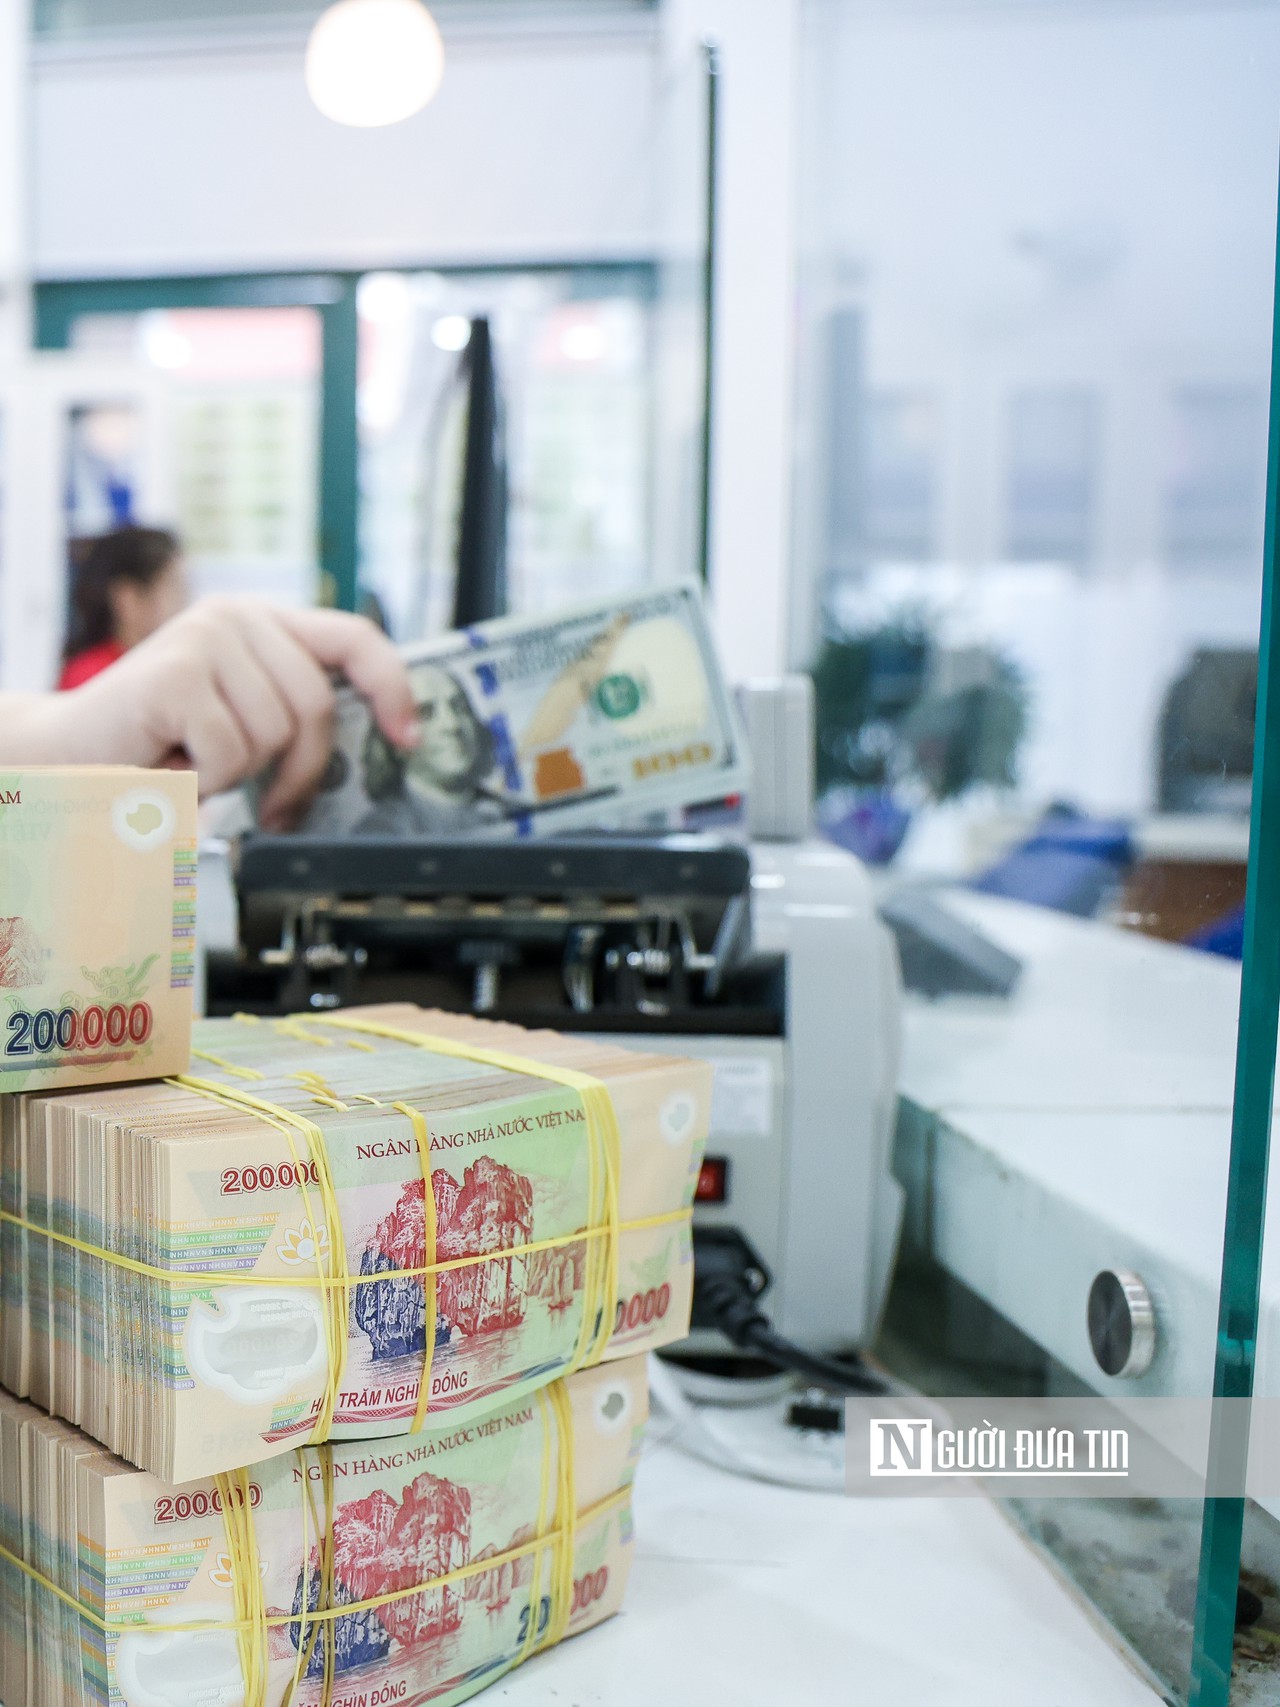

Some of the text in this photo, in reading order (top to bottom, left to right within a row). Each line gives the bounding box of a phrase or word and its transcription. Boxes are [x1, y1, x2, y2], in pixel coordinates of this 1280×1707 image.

[356, 1138, 412, 1160] NGÂN
[467, 1122, 496, 1145] NHÀ
[497, 1116, 533, 1138] NƯỚC
[535, 1110, 564, 1131] VIỆT
[339, 1388, 382, 1408] TRĂM
[384, 1379, 421, 1405] NGHÌ
[432, 1368, 469, 1395] ĐỒNG
[352, 1454, 403, 1477] HÀNG
[405, 1439, 436, 1465] NHÀ
[438, 1428, 474, 1453] NƯỚC
[505, 1407, 534, 1430] NAM
[370, 1680, 407, 1707] ĐỒNG
